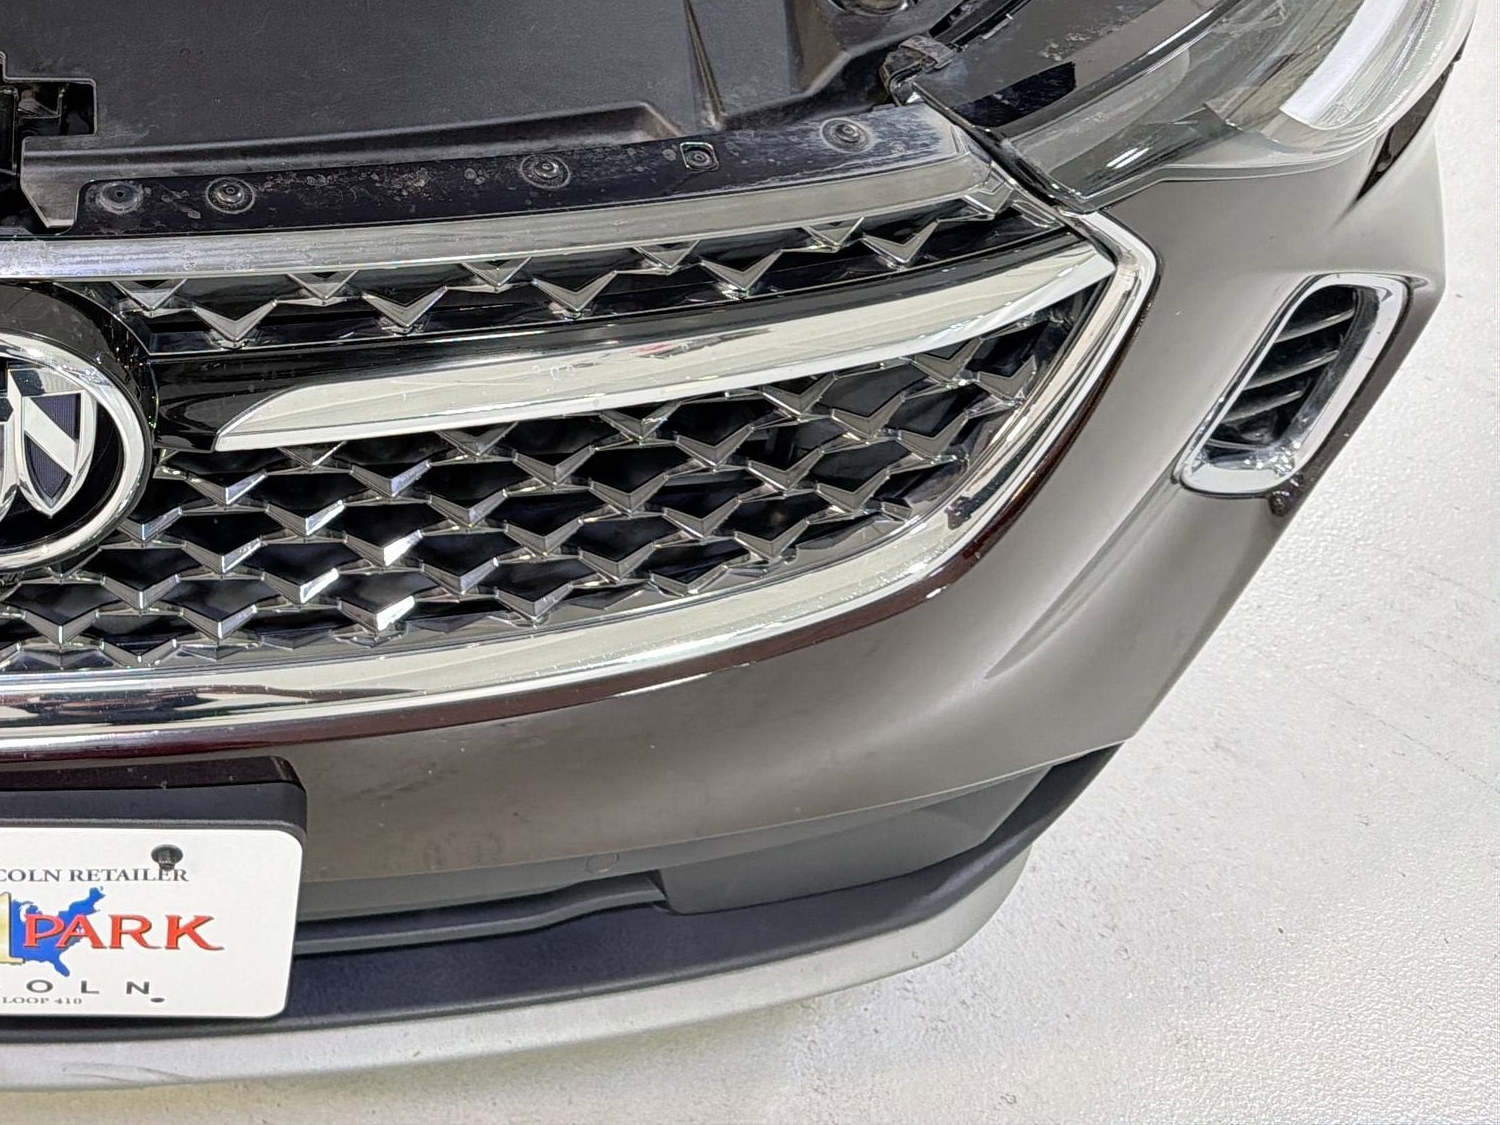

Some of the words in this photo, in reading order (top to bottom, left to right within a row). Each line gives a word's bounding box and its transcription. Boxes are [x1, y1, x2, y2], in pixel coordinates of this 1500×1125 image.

[68, 868, 190, 882] RETAILER
[24, 913, 225, 950] PARK
[2, 996, 50, 1005] LOOP
[54, 997, 83, 1005] 410
